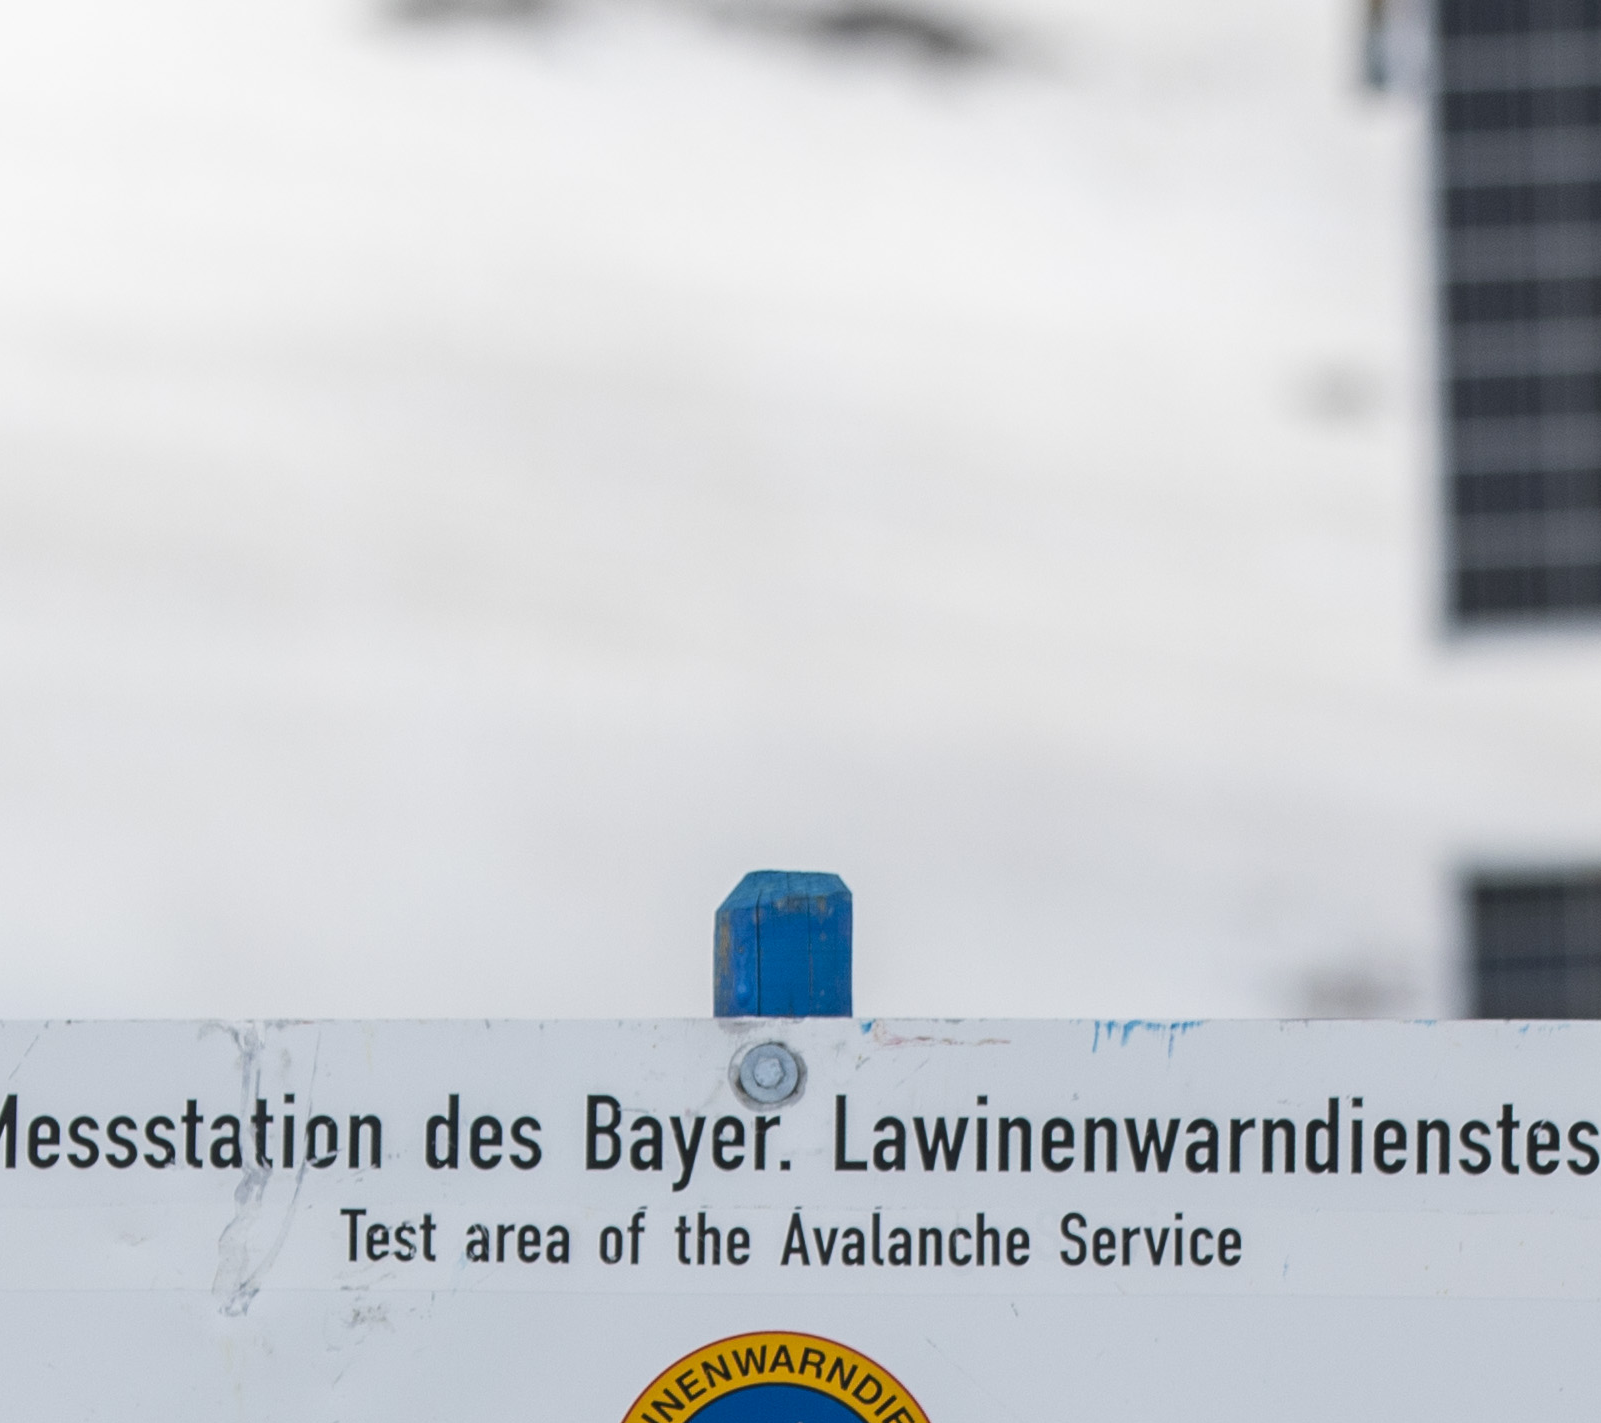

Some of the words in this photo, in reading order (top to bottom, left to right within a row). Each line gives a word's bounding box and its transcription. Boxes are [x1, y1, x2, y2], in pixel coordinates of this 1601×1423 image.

[424, 1092, 543, 1171] des
[585, 1093, 792, 1193] Bayer.
[834, 1093, 1601, 1178] Lawinenwarndienstes
[339, 1207, 437, 1263] Test
[465, 1222, 571, 1265] area
[598, 1210, 647, 1266] of
[674, 1211, 751, 1267] the
[779, 1211, 1031, 1267] Avalanche
[1059, 1211, 1243, 1268] Service
